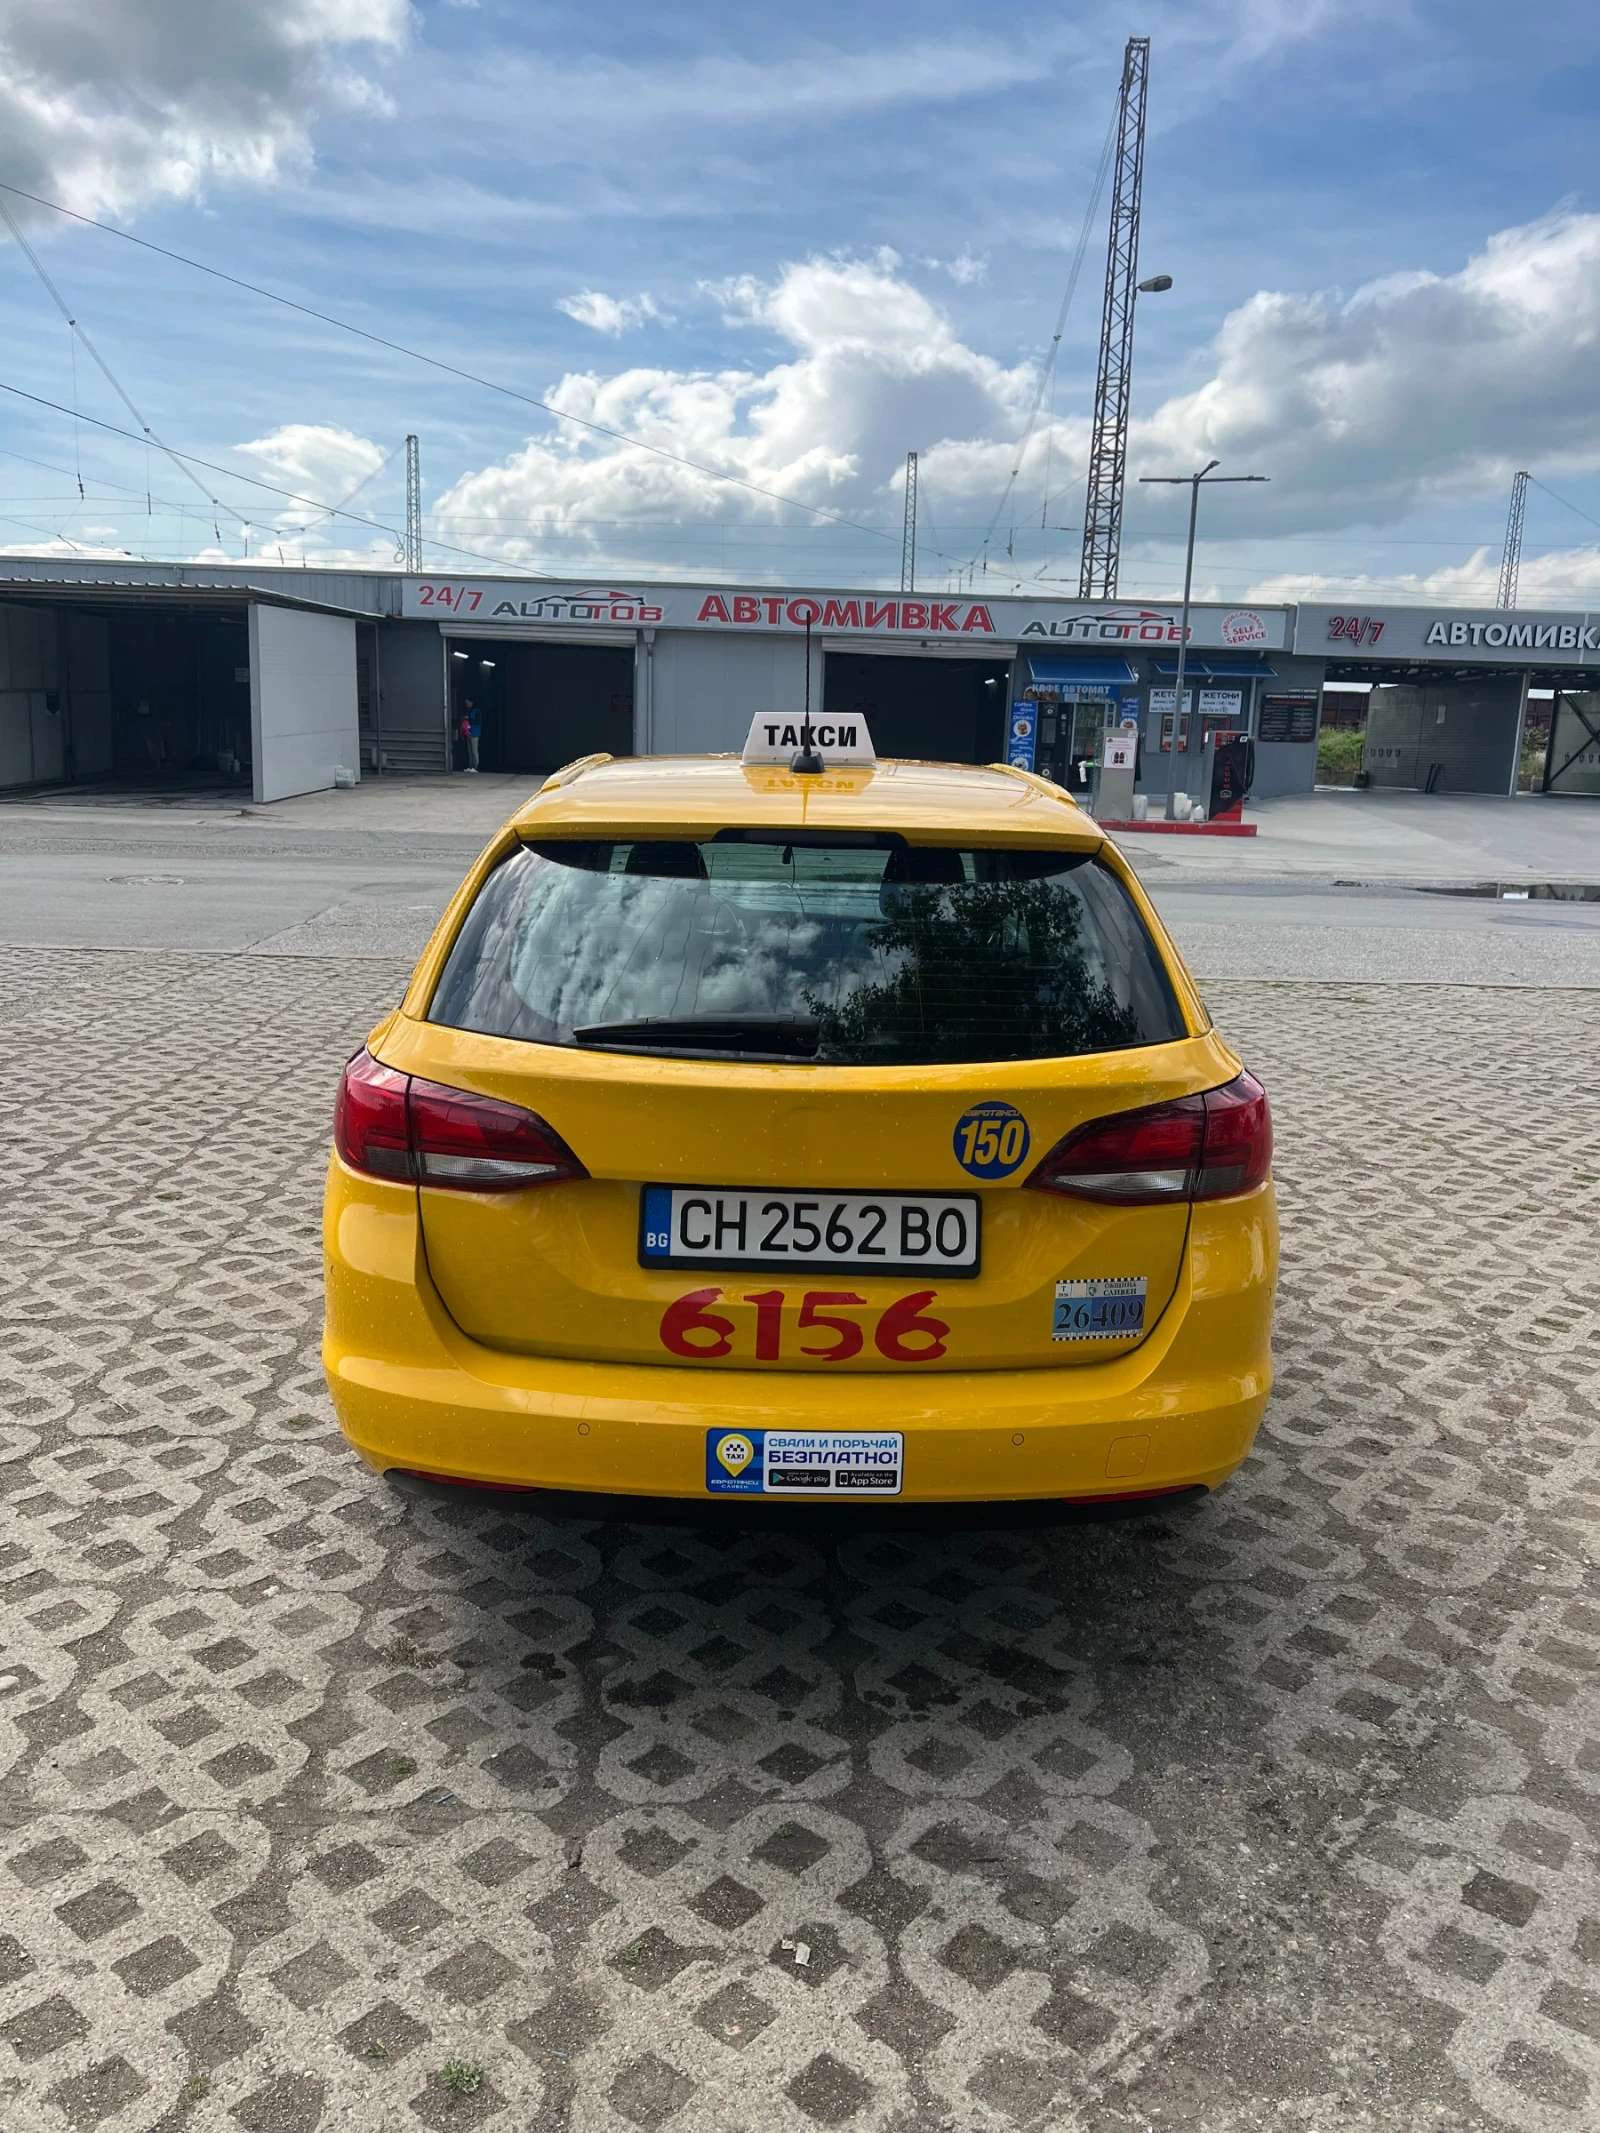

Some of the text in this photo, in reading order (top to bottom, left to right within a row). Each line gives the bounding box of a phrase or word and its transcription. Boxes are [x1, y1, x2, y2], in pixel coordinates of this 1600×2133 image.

[418, 585, 483, 612] 24/7
[697, 594, 995, 632] АВТОМИВКА
[1226, 631, 1267, 644] SERVICE
[1232, 625, 1255, 636] SELF
[1329, 616, 1385, 645] 24/7
[1426, 621, 1600, 649] АВТОМИВК
[1032, 684, 1111, 694] КАФЕ АВТОМАТ
[764, 725, 857, 747] ТАКСИ
[960, 1119, 1025, 1165] 150
[680, 1199, 967, 1257] CH 2562 BO
[646, 1233, 668, 1248] BG
[1103, 1288, 1137, 1296] СЛИВЕН
[659, 1287, 951, 1362] 6156
[768, 1437, 898, 1448] СВАЛИ И ПОРЪЧАЙ
[768, 1450, 898, 1464] БЕЗПЛАТНО!
[786, 1474, 828, 1484] Google play
[850, 1478, 869, 1486] App
